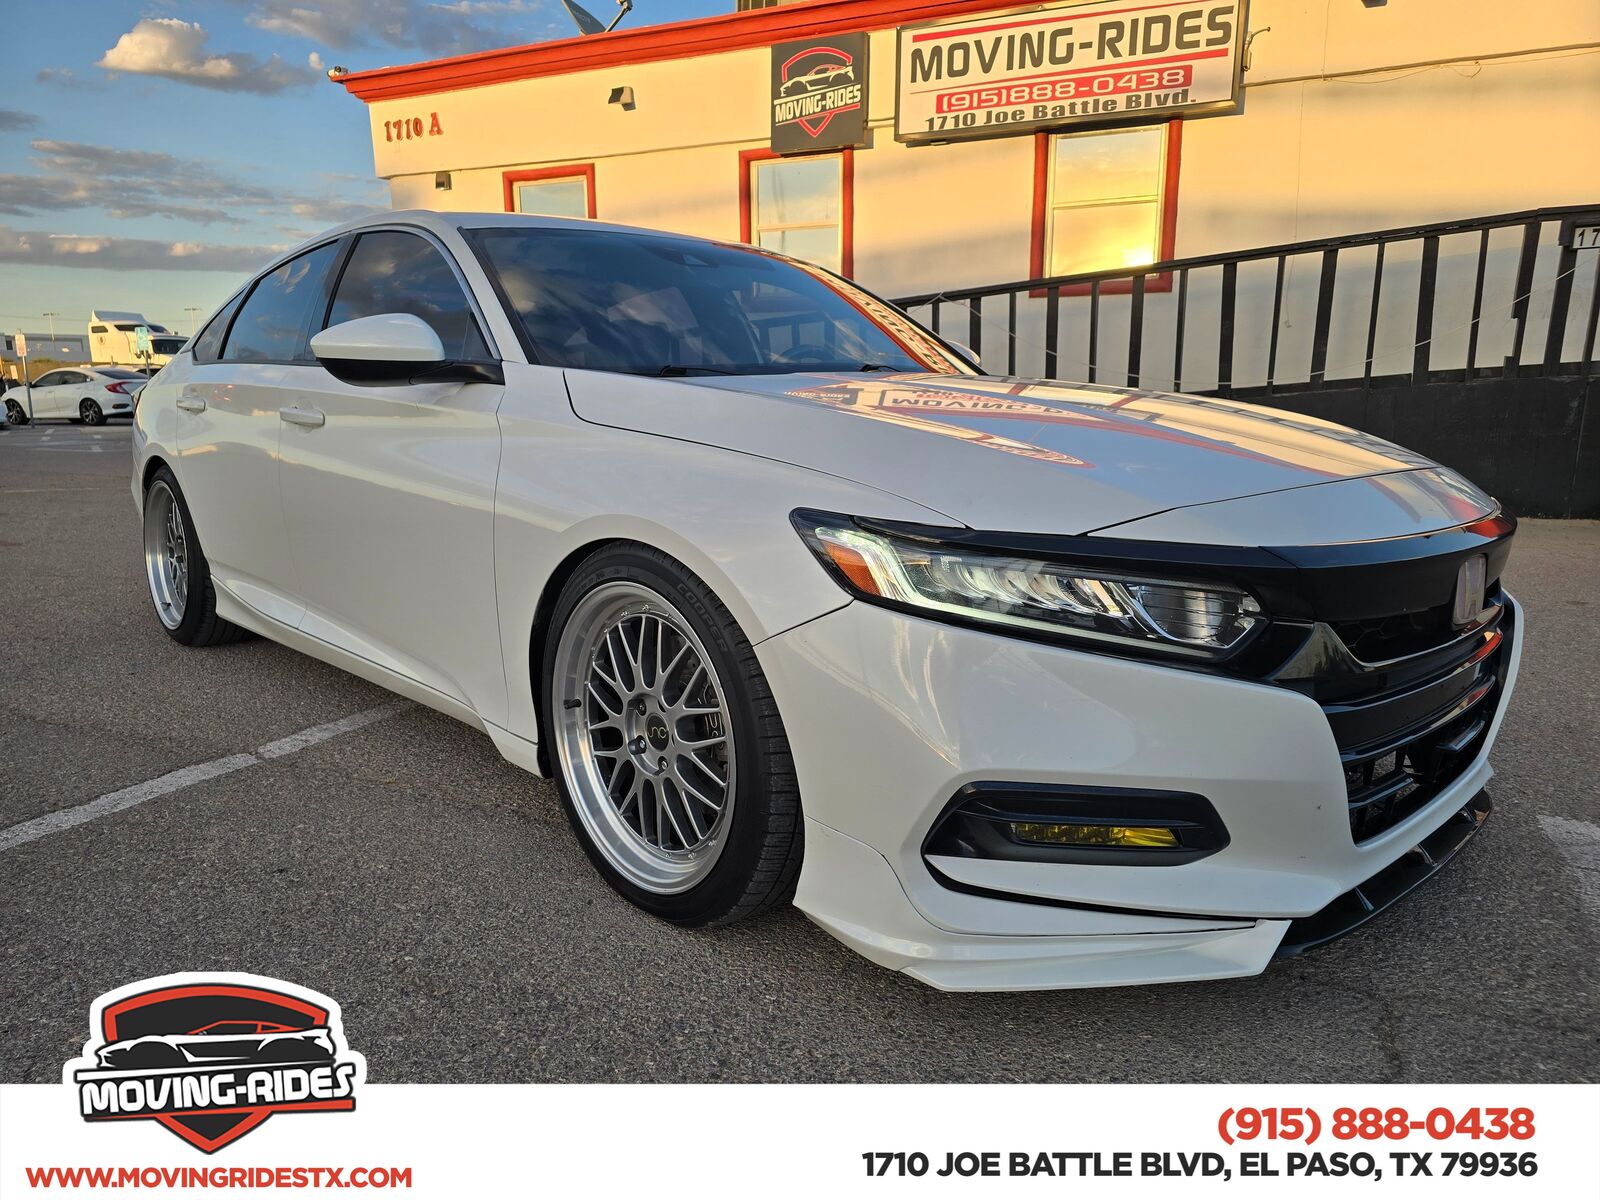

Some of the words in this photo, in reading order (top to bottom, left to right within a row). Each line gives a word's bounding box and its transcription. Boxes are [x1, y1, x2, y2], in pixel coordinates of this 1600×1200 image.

[911, 5, 1234, 83] MOVING-RIDES
[776, 84, 861, 122] MOVING-RIDES
[925, 112, 976, 132] 1710
[984, 109, 1025, 125] Joe
[1033, 98, 1117, 119] Battle
[1126, 89, 1196, 110] Blvd.
[942, 69, 1185, 111] (915)888-0438
[384, 117, 423, 142] 1710
[429, 112, 443, 136] A
